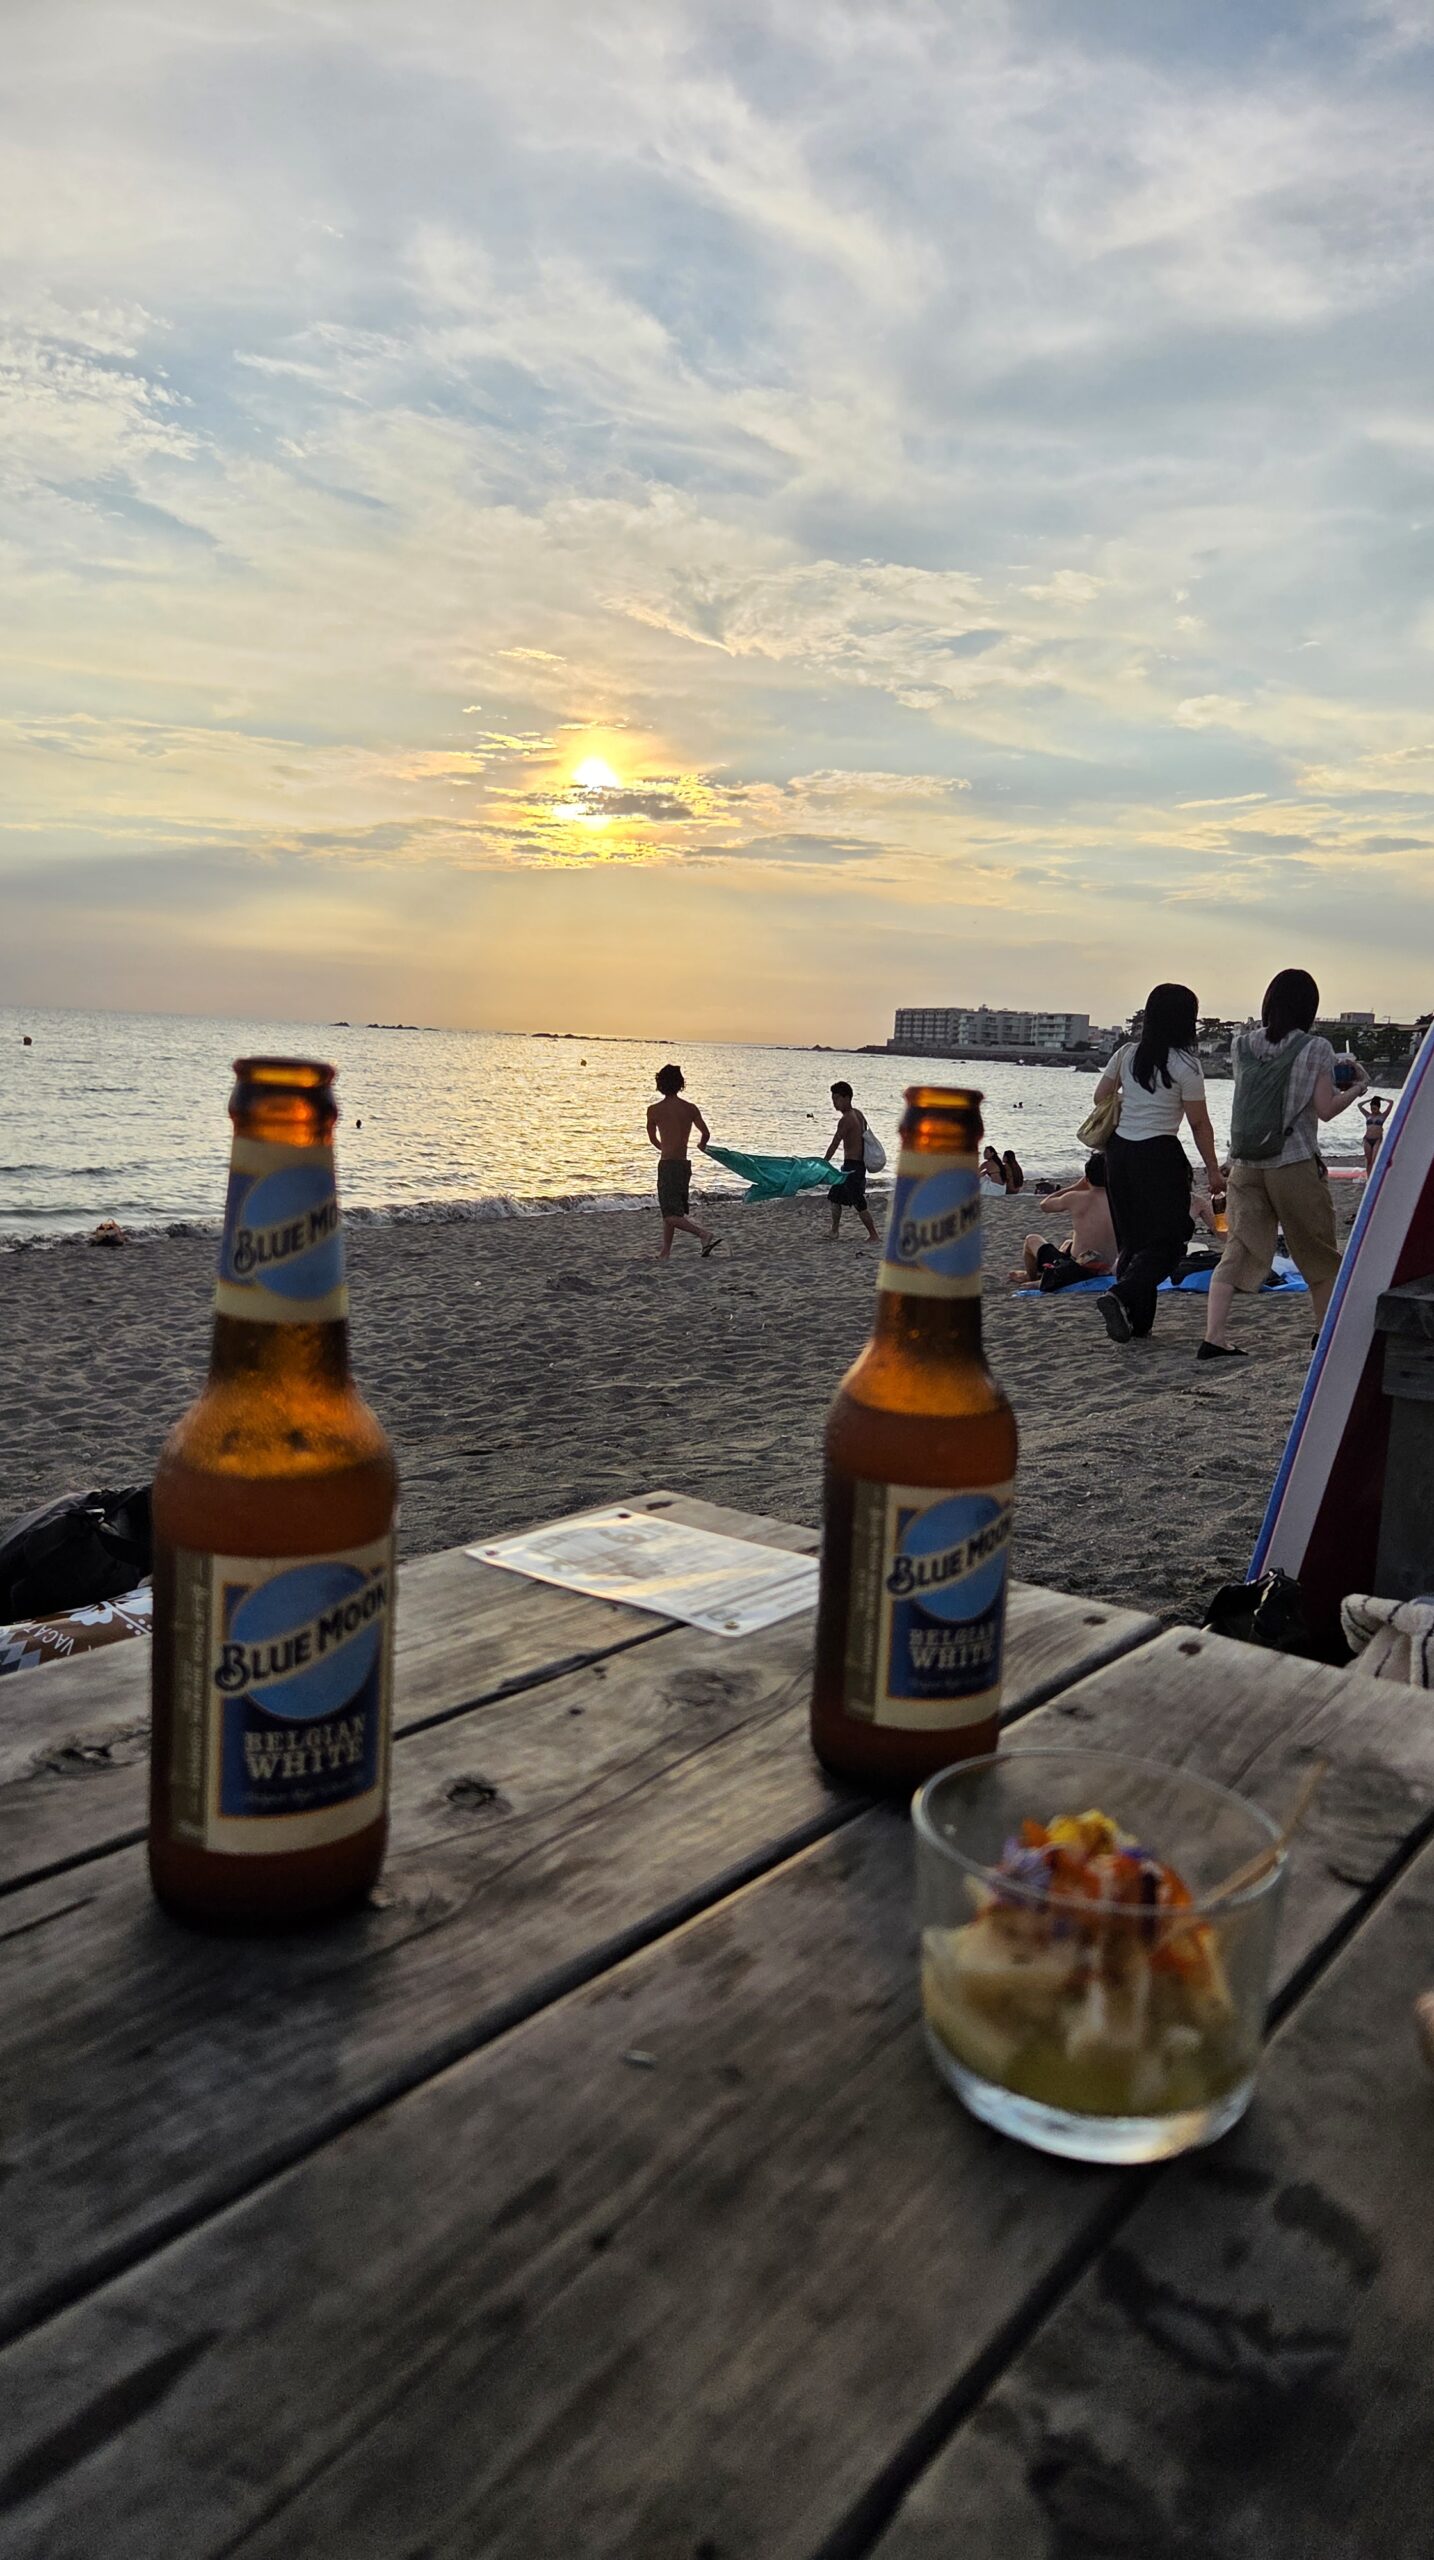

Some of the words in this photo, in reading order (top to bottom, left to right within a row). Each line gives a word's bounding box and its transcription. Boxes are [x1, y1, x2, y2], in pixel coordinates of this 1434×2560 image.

[234, 1221, 306, 1274] BLUE
[901, 1214, 957, 1256] BLUE
[886, 1548, 962, 1595] BLUE
[214, 1632, 313, 1691] BLUE
[909, 1642, 994, 1670] WHITE
[244, 1713, 367, 1753] BELGIAN
[246, 1737, 365, 1781] WHITE
